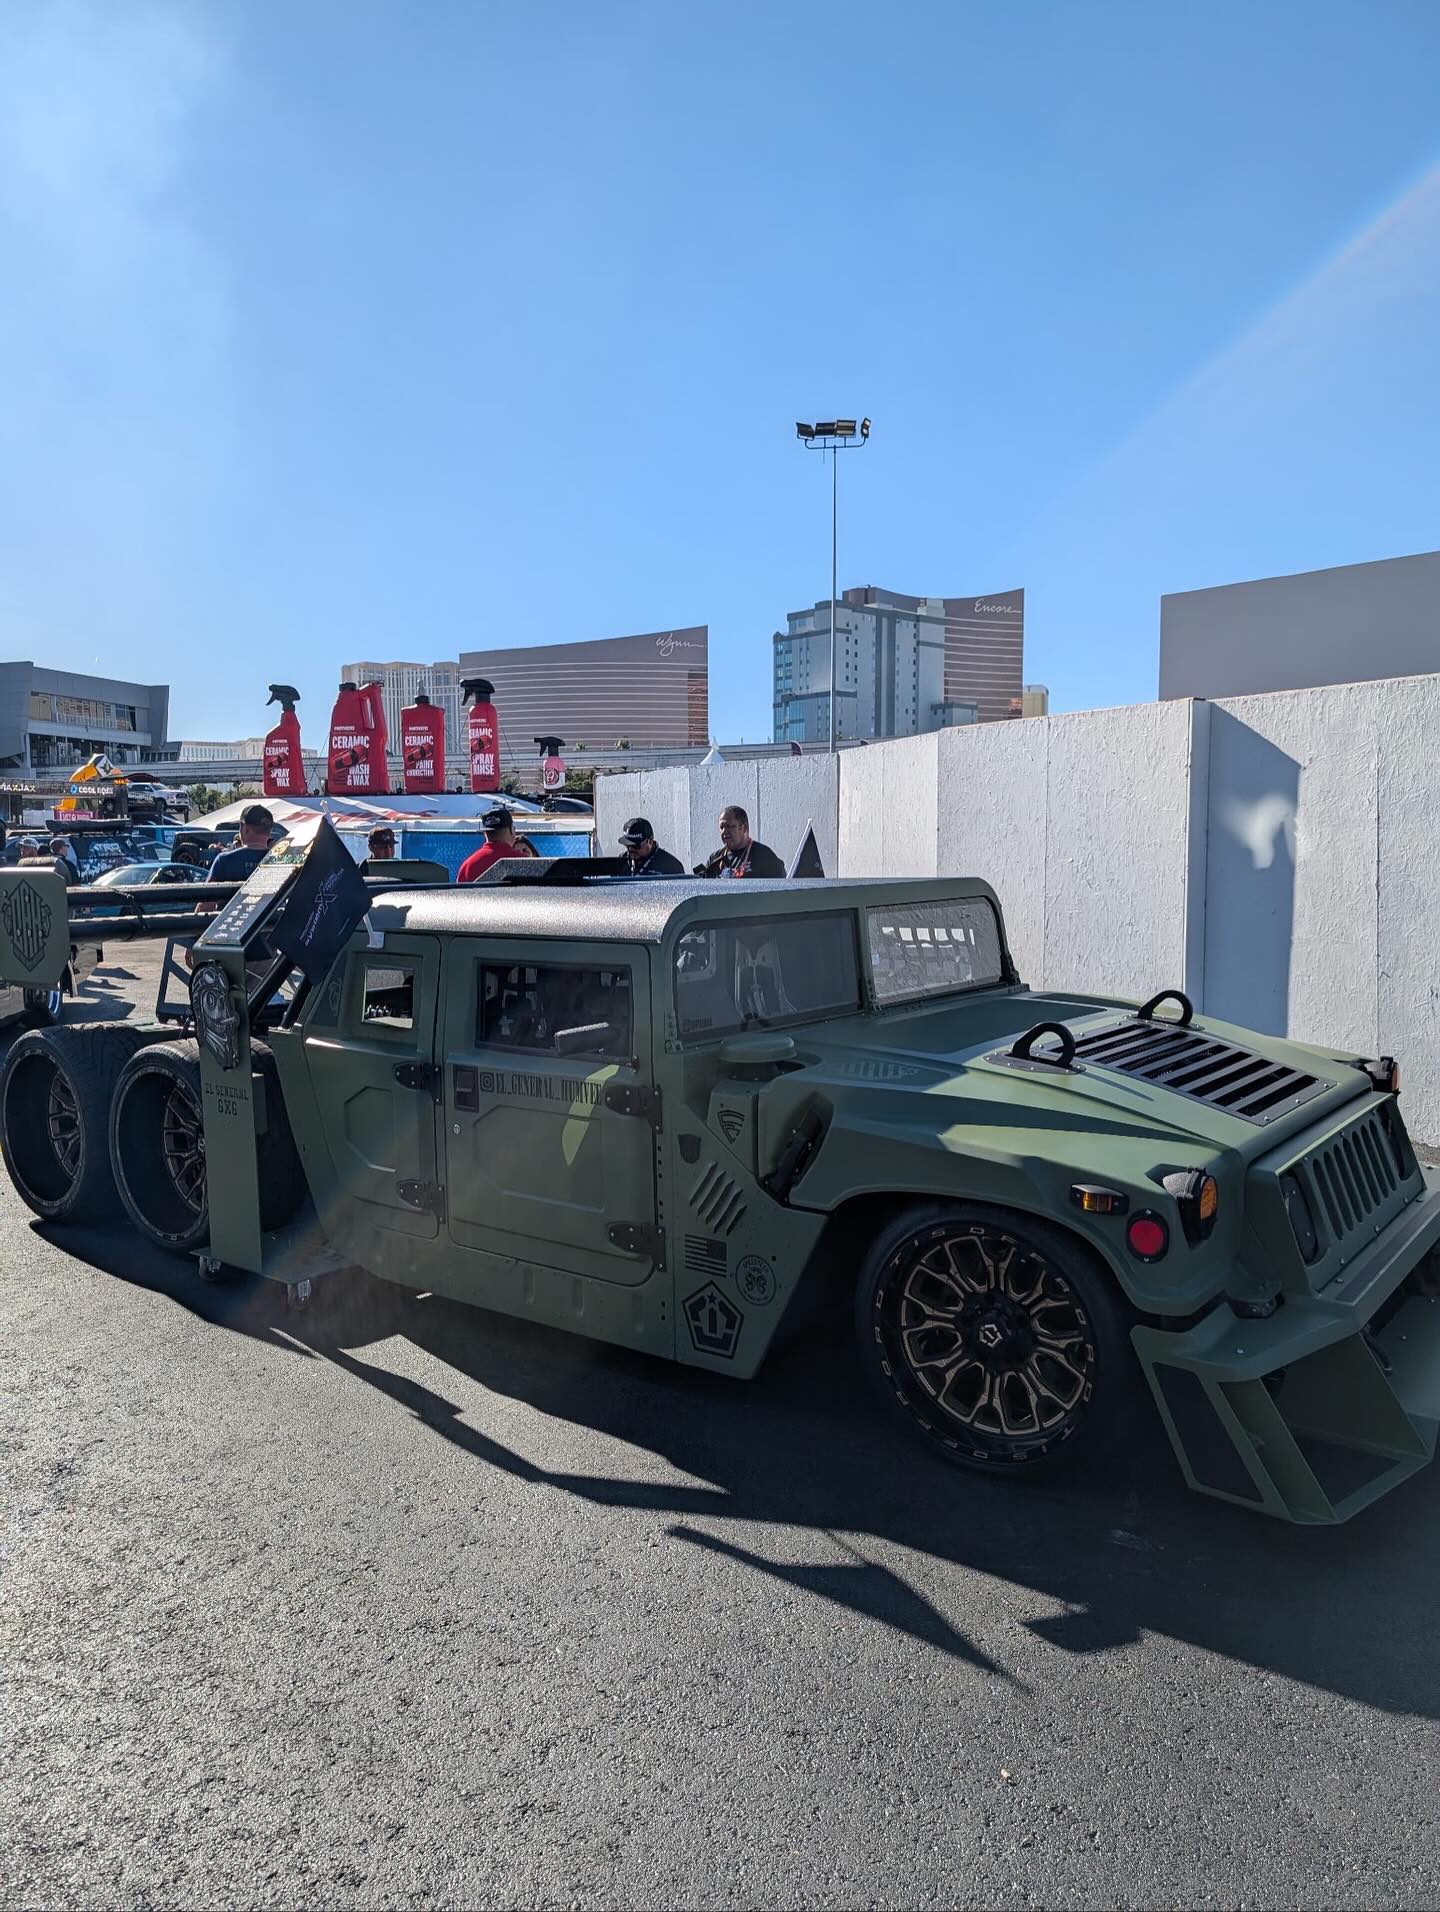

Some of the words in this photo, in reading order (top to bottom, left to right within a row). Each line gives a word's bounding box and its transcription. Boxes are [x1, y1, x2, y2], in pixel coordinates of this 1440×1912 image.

[974, 598, 1022, 614] Encore
[655, 633, 705, 657] Wynn
[332, 735, 370, 749] CERAMIC
[404, 735, 434, 746] CERAMIC
[265, 746, 289, 756] CERAMIC
[472, 753, 494, 766] SPRAY
[270, 768, 290, 779] SPRAY
[348, 764, 370, 775] WASH
[406, 769, 434, 777] CORRECTION
[473, 765, 495, 776] RINSE
[276, 778, 290, 787] WAX
